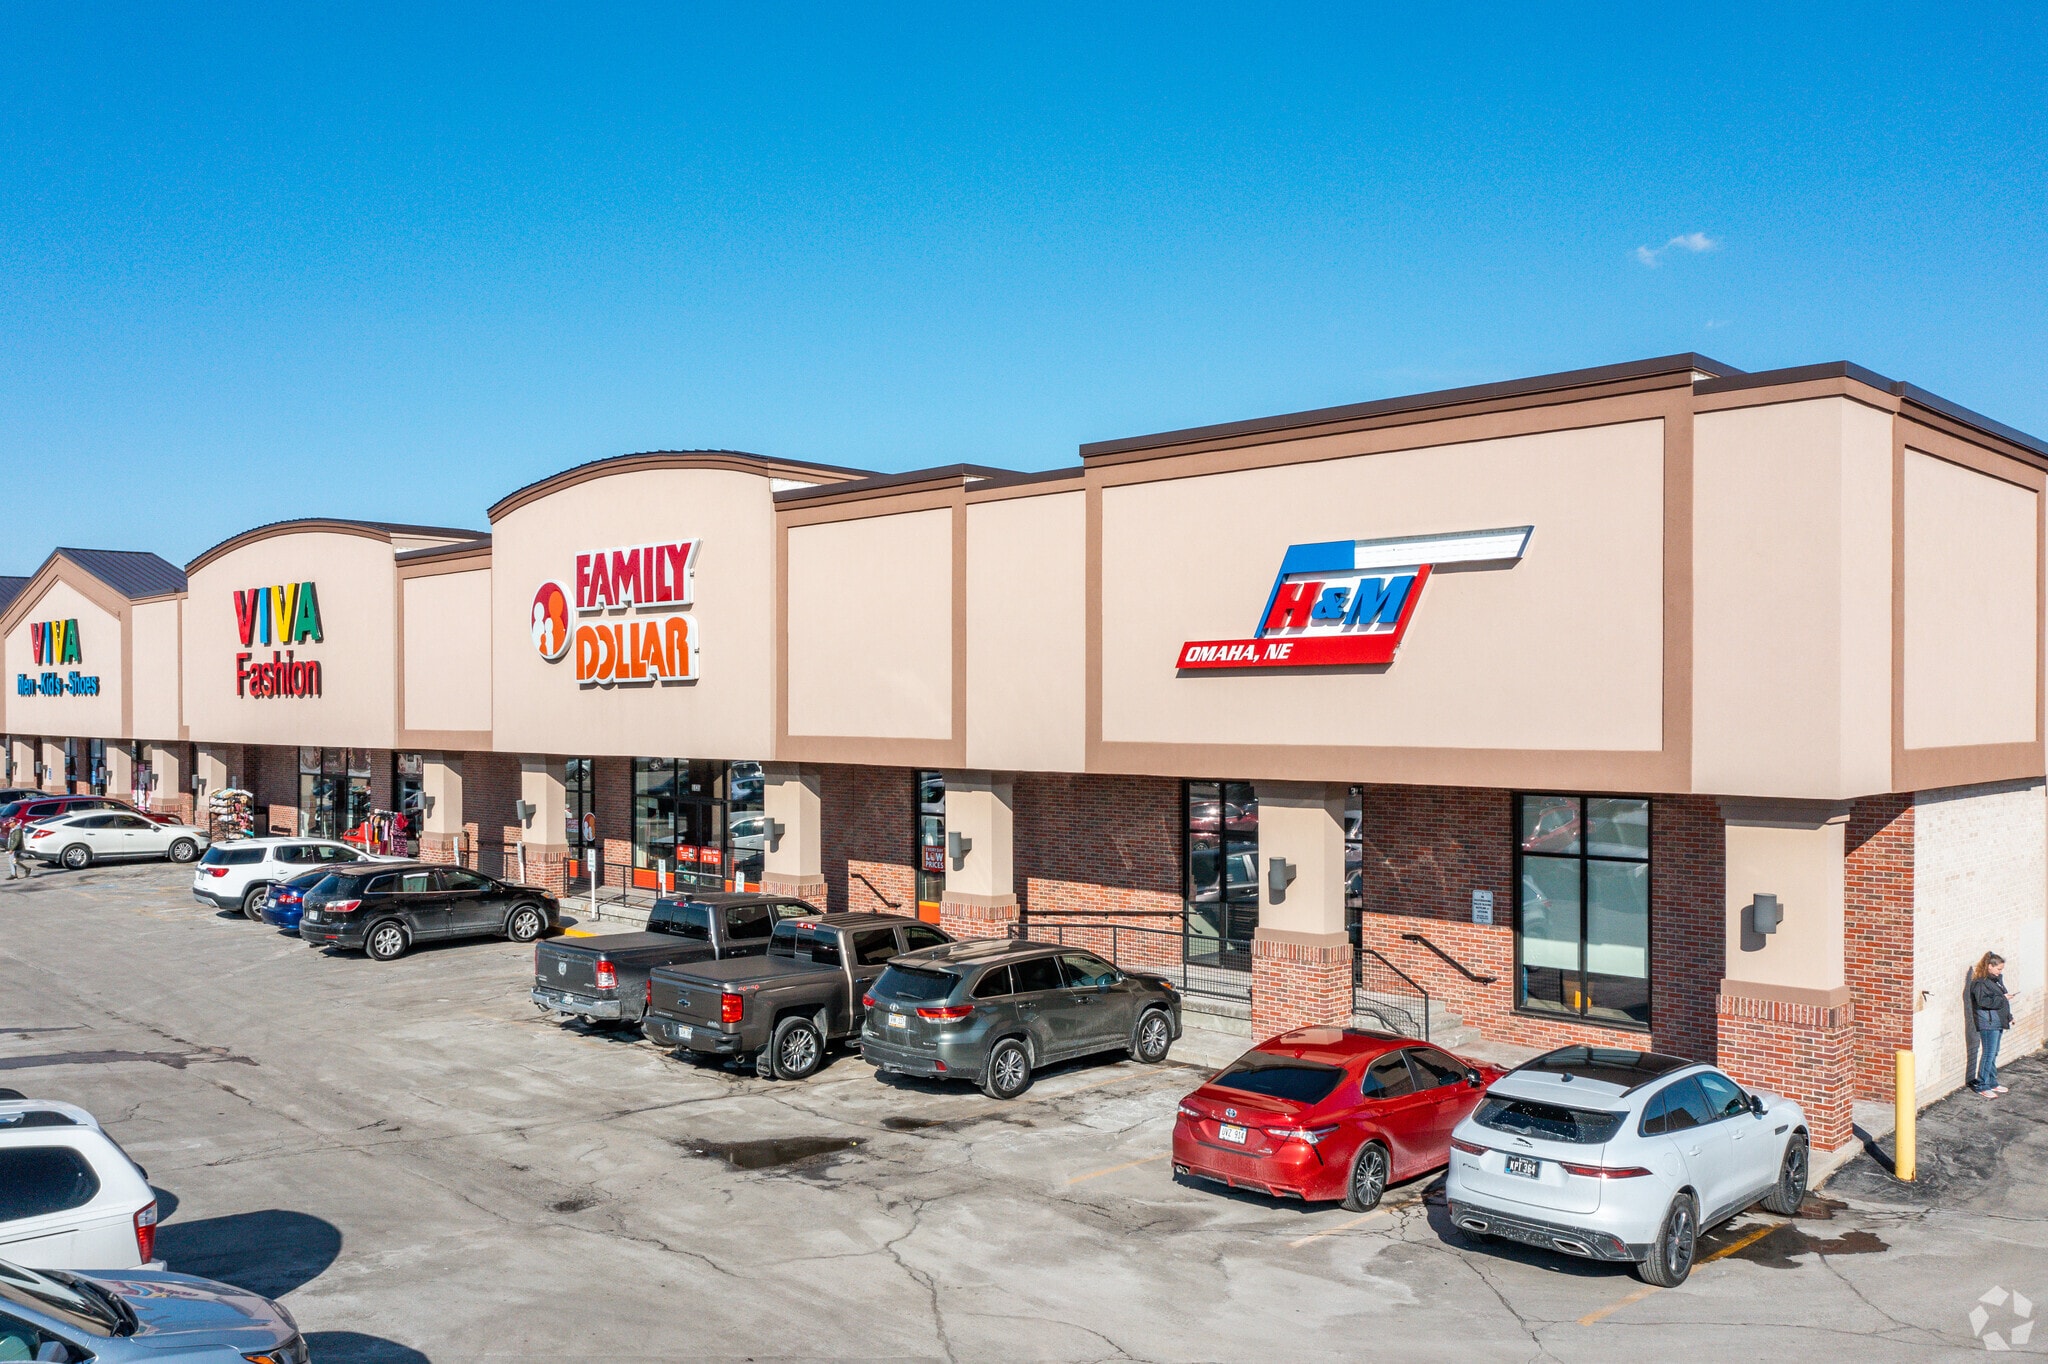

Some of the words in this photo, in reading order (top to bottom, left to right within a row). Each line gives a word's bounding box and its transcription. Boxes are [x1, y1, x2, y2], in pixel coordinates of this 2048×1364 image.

[575, 541, 692, 608] FAMILY
[233, 581, 323, 646] VIVA
[1263, 575, 1416, 629] H&M
[30, 618, 81, 665] VIVA
[575, 616, 690, 680] DOLLAR
[1185, 644, 1260, 663] OMAHA,
[1263, 642, 1294, 660] NE
[17, 673, 36, 696] Men
[68, 671, 99, 696] Shoes
[236, 650, 321, 698] Fashion
[925, 860, 944, 869] PRICES
[1522, 1163, 1536, 1175] 364
